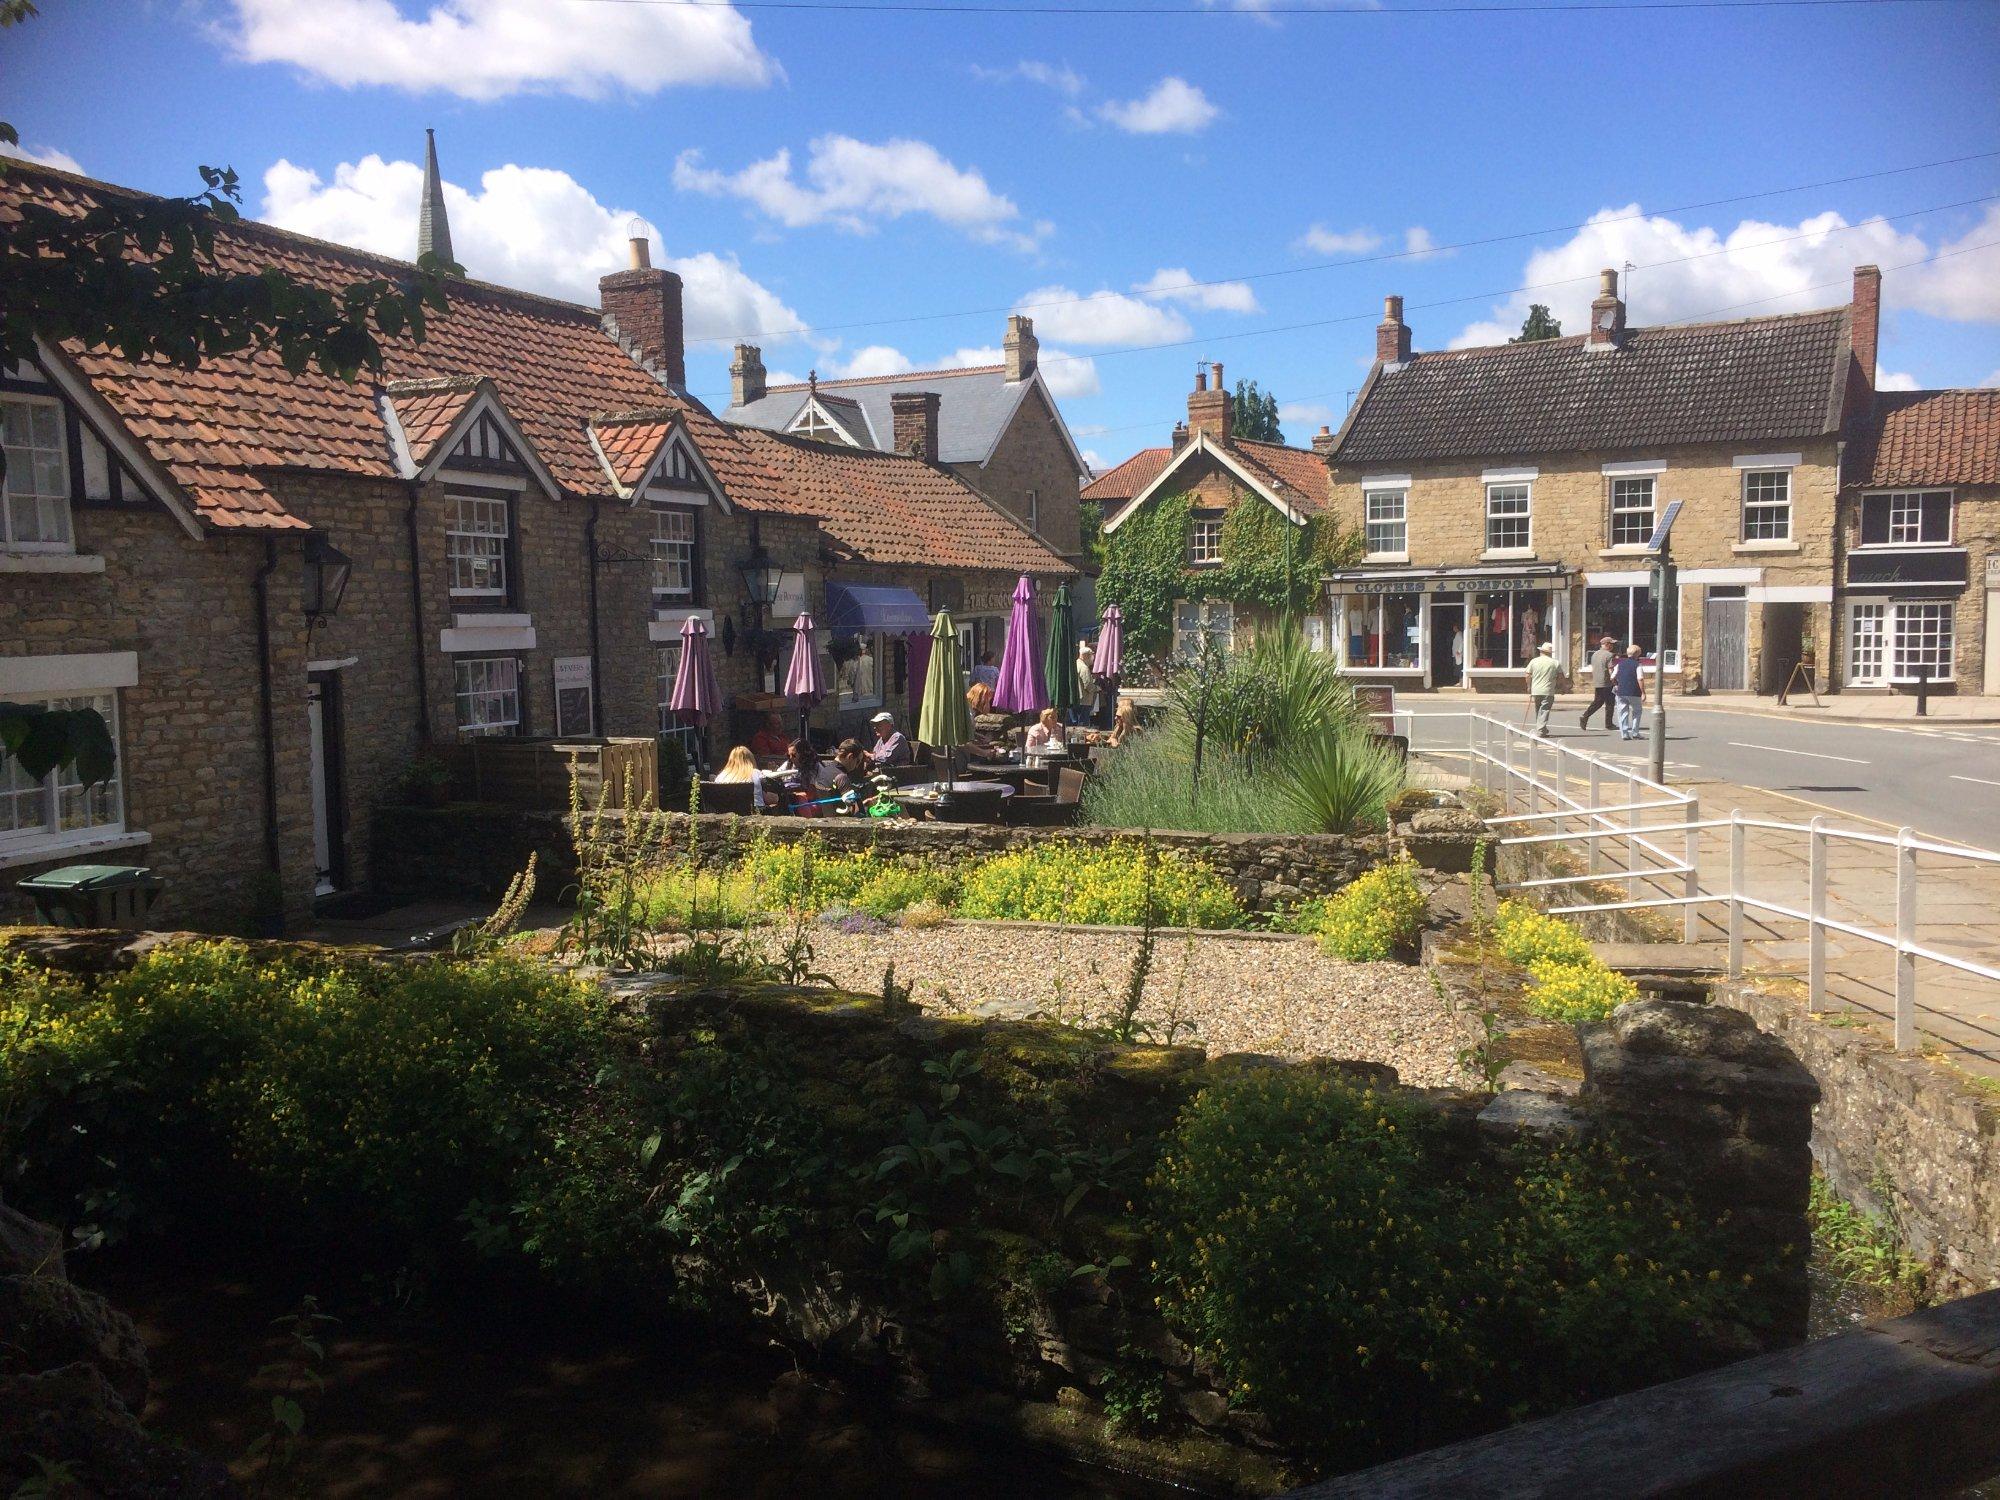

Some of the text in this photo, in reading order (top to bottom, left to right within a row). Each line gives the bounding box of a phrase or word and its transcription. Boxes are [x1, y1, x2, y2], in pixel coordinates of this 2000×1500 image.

[1987, 559, 1999, 570] IC
[1354, 579, 1535, 593] CLOTHES 4 COMFORT
